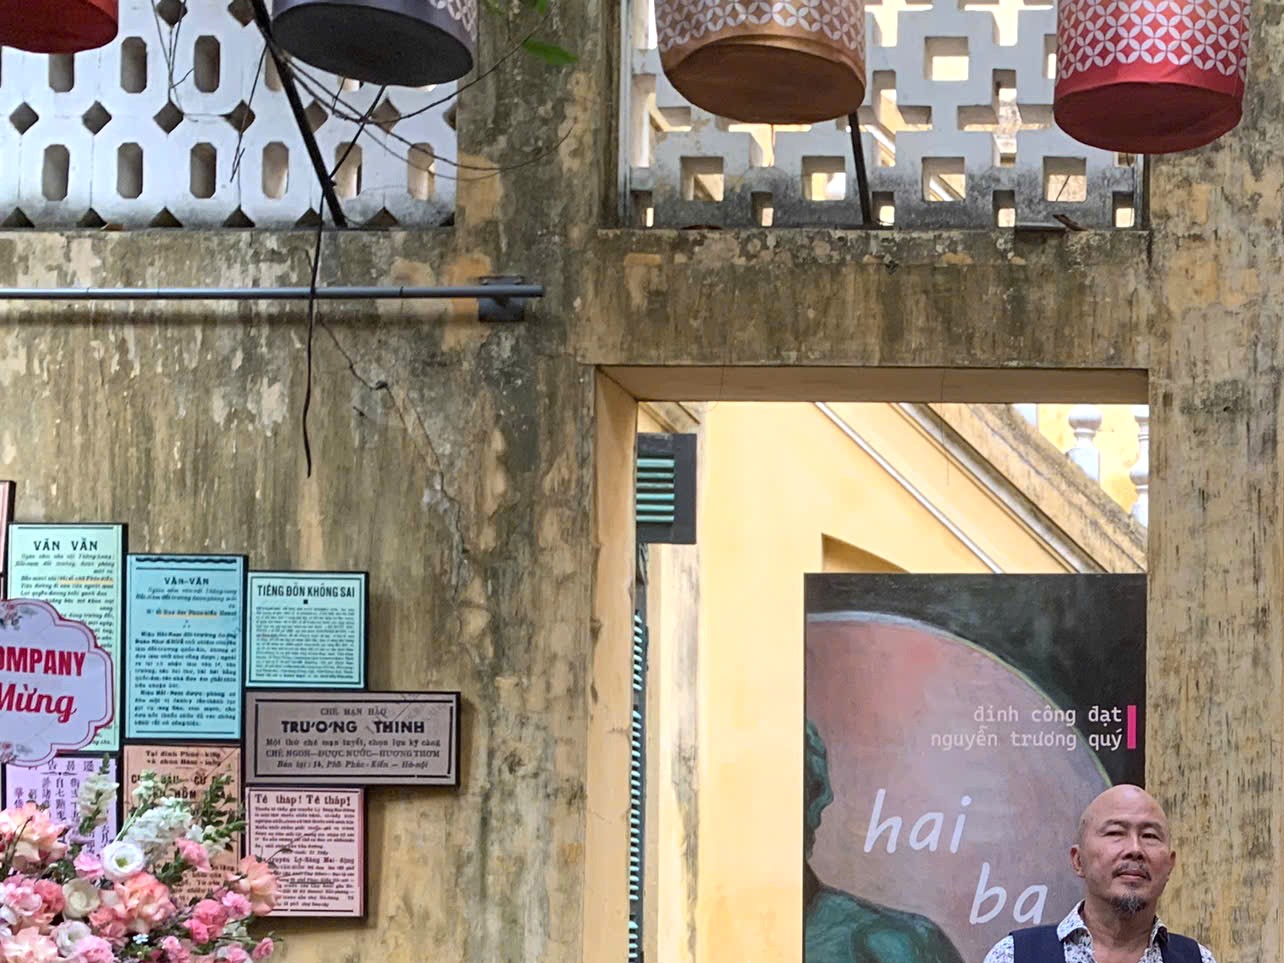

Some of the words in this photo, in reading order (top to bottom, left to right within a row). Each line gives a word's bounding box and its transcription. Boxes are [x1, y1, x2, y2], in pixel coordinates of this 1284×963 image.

[340, 586, 355, 598] SAI
[1032, 704, 1076, 727] công
[1088, 705, 1122, 727] đạt
[931, 725, 998, 750] nguyễn
[1010, 730, 1077, 750] trương
[1088, 728, 1123, 750] quý
[863, 788, 972, 854] hai
[968, 862, 1049, 925] ba
